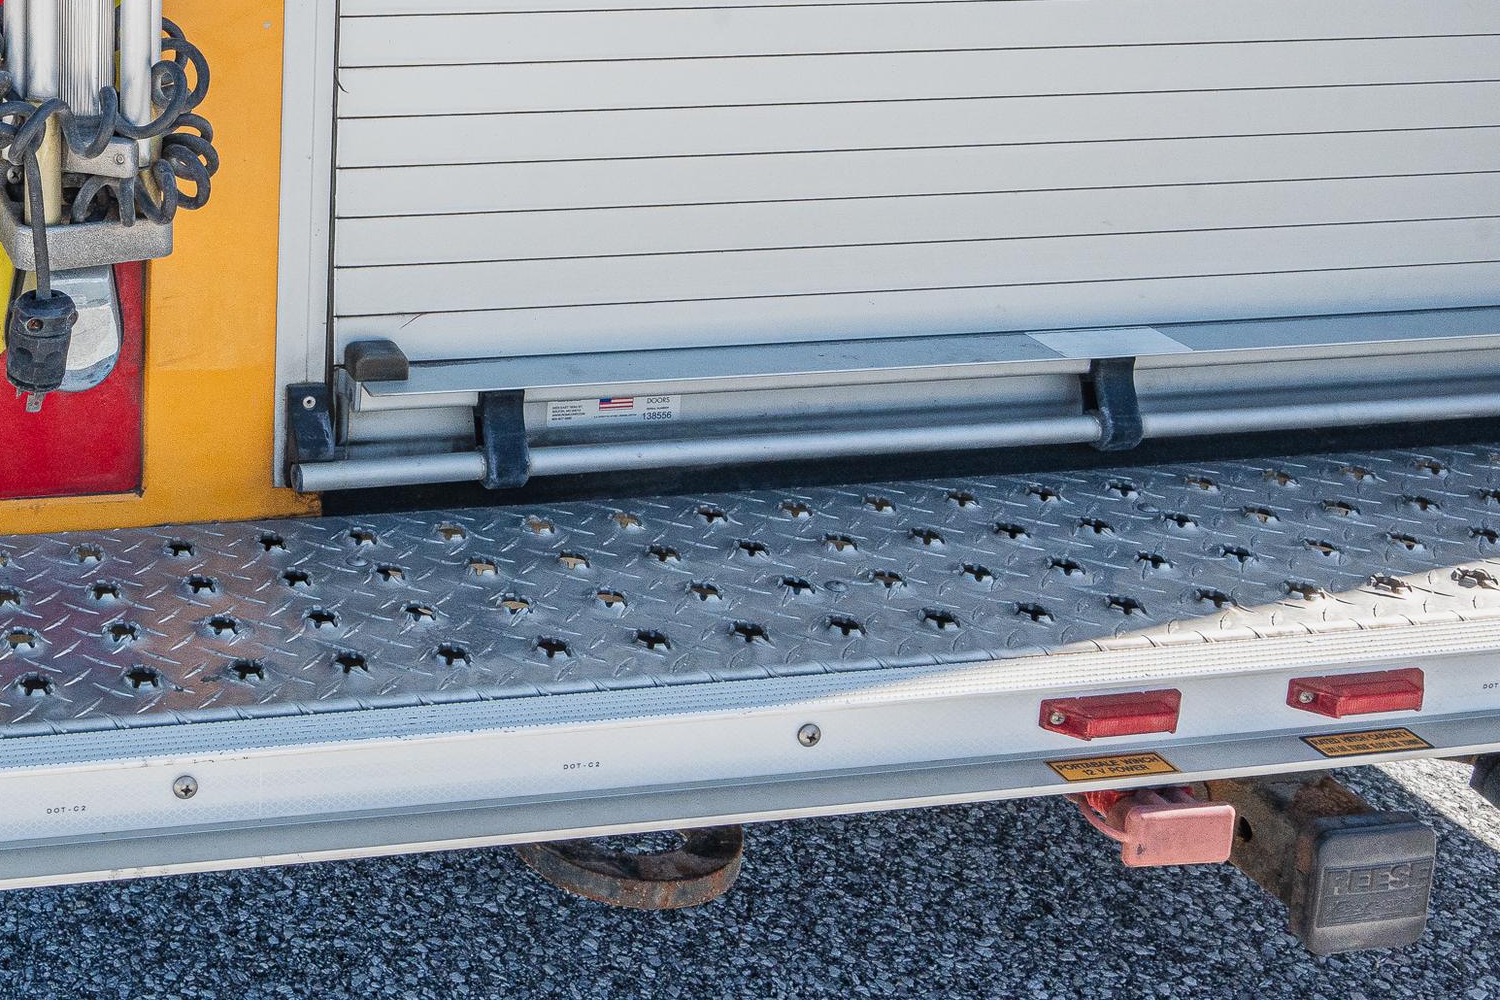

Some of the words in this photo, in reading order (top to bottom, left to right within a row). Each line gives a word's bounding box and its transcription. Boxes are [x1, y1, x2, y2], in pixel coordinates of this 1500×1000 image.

[642, 411, 672, 420] 138556
[563, 761, 600, 770] DOT-C2
[1122, 756, 1158, 766] WINCH
[1107, 764, 1150, 773] POWER
[46, 805, 86, 814] DOT-C2
[1327, 861, 1430, 896] REESE
